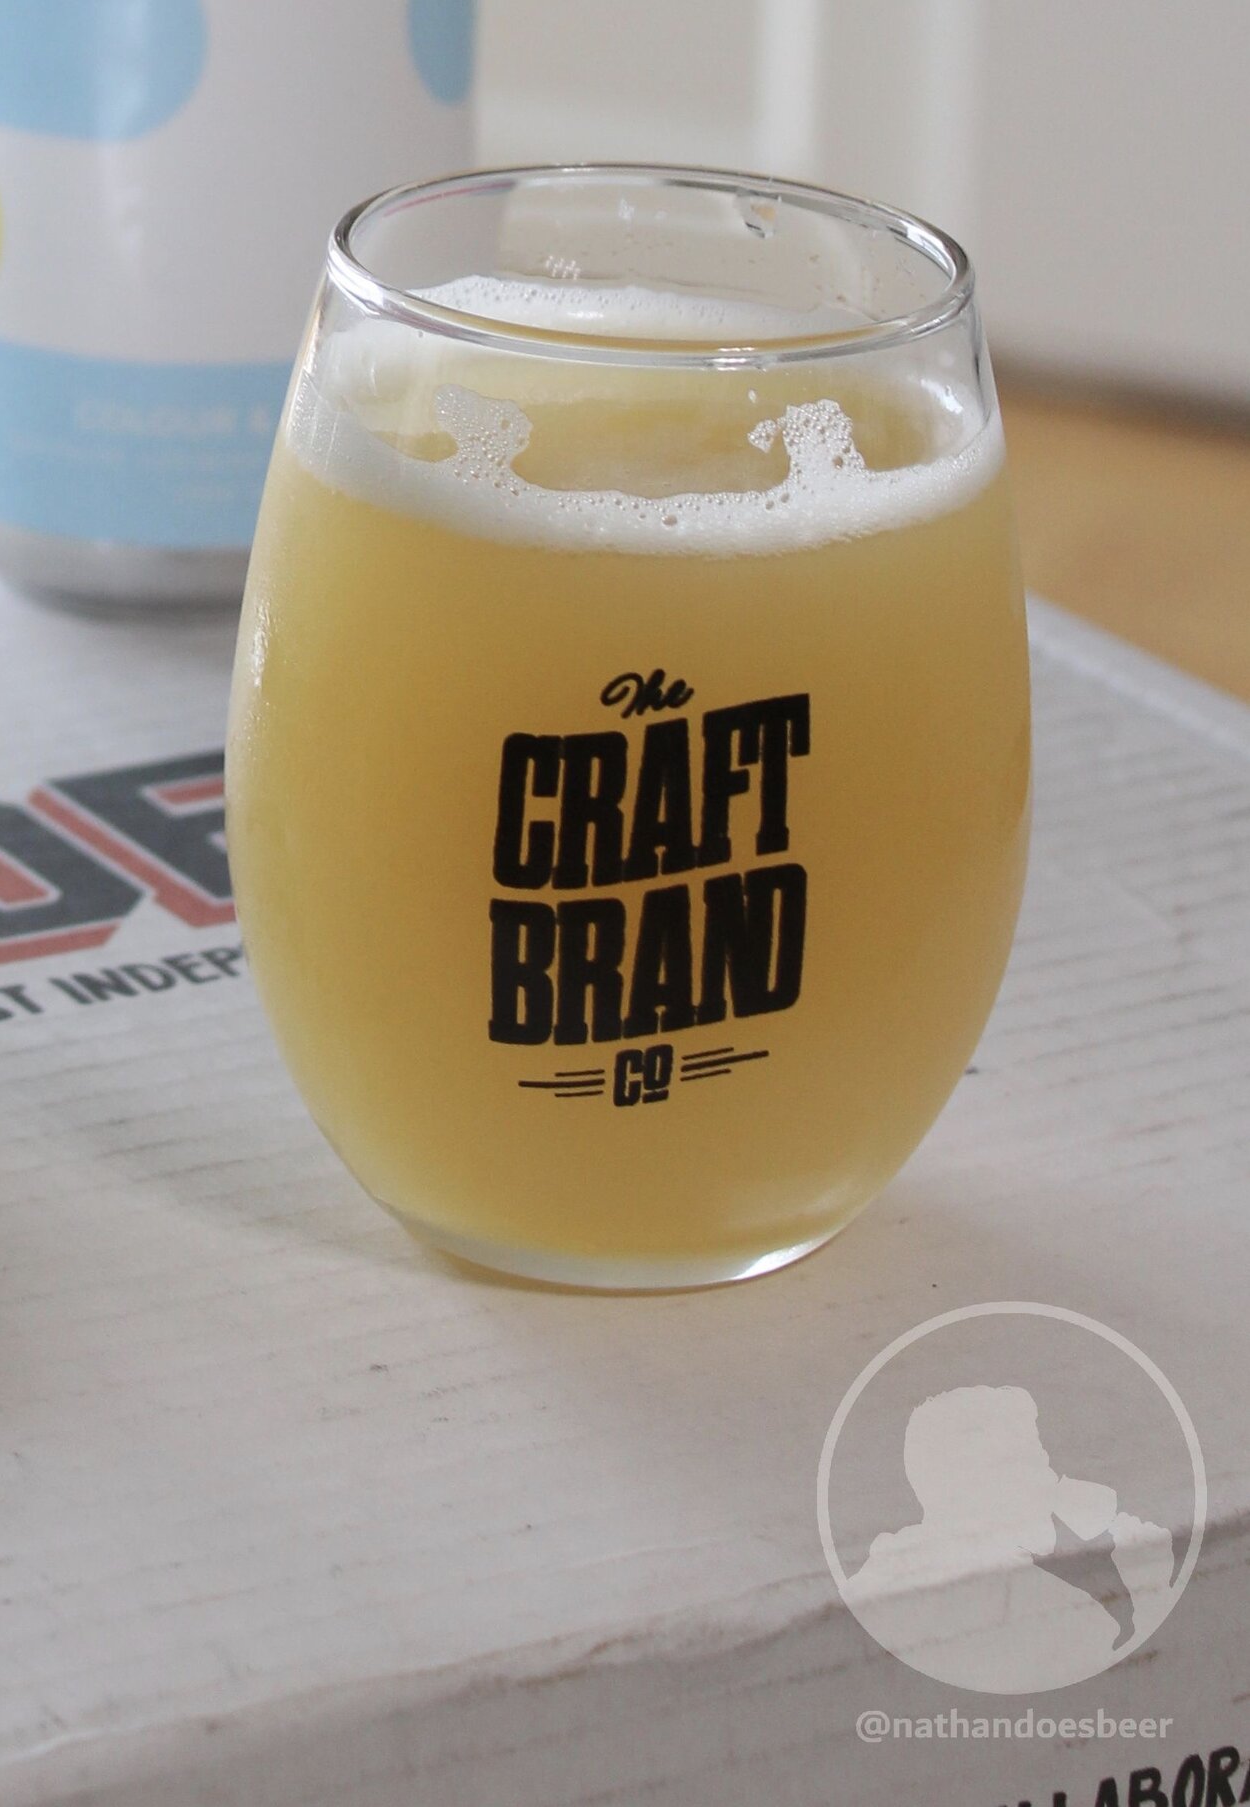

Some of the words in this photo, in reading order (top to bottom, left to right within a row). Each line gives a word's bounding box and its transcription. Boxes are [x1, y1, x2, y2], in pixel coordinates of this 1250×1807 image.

[600, 669, 694, 719] The
[493, 693, 811, 890] CRAFT
[488, 863, 808, 1045] BRAND
[613, 1044, 674, 1107] CO
